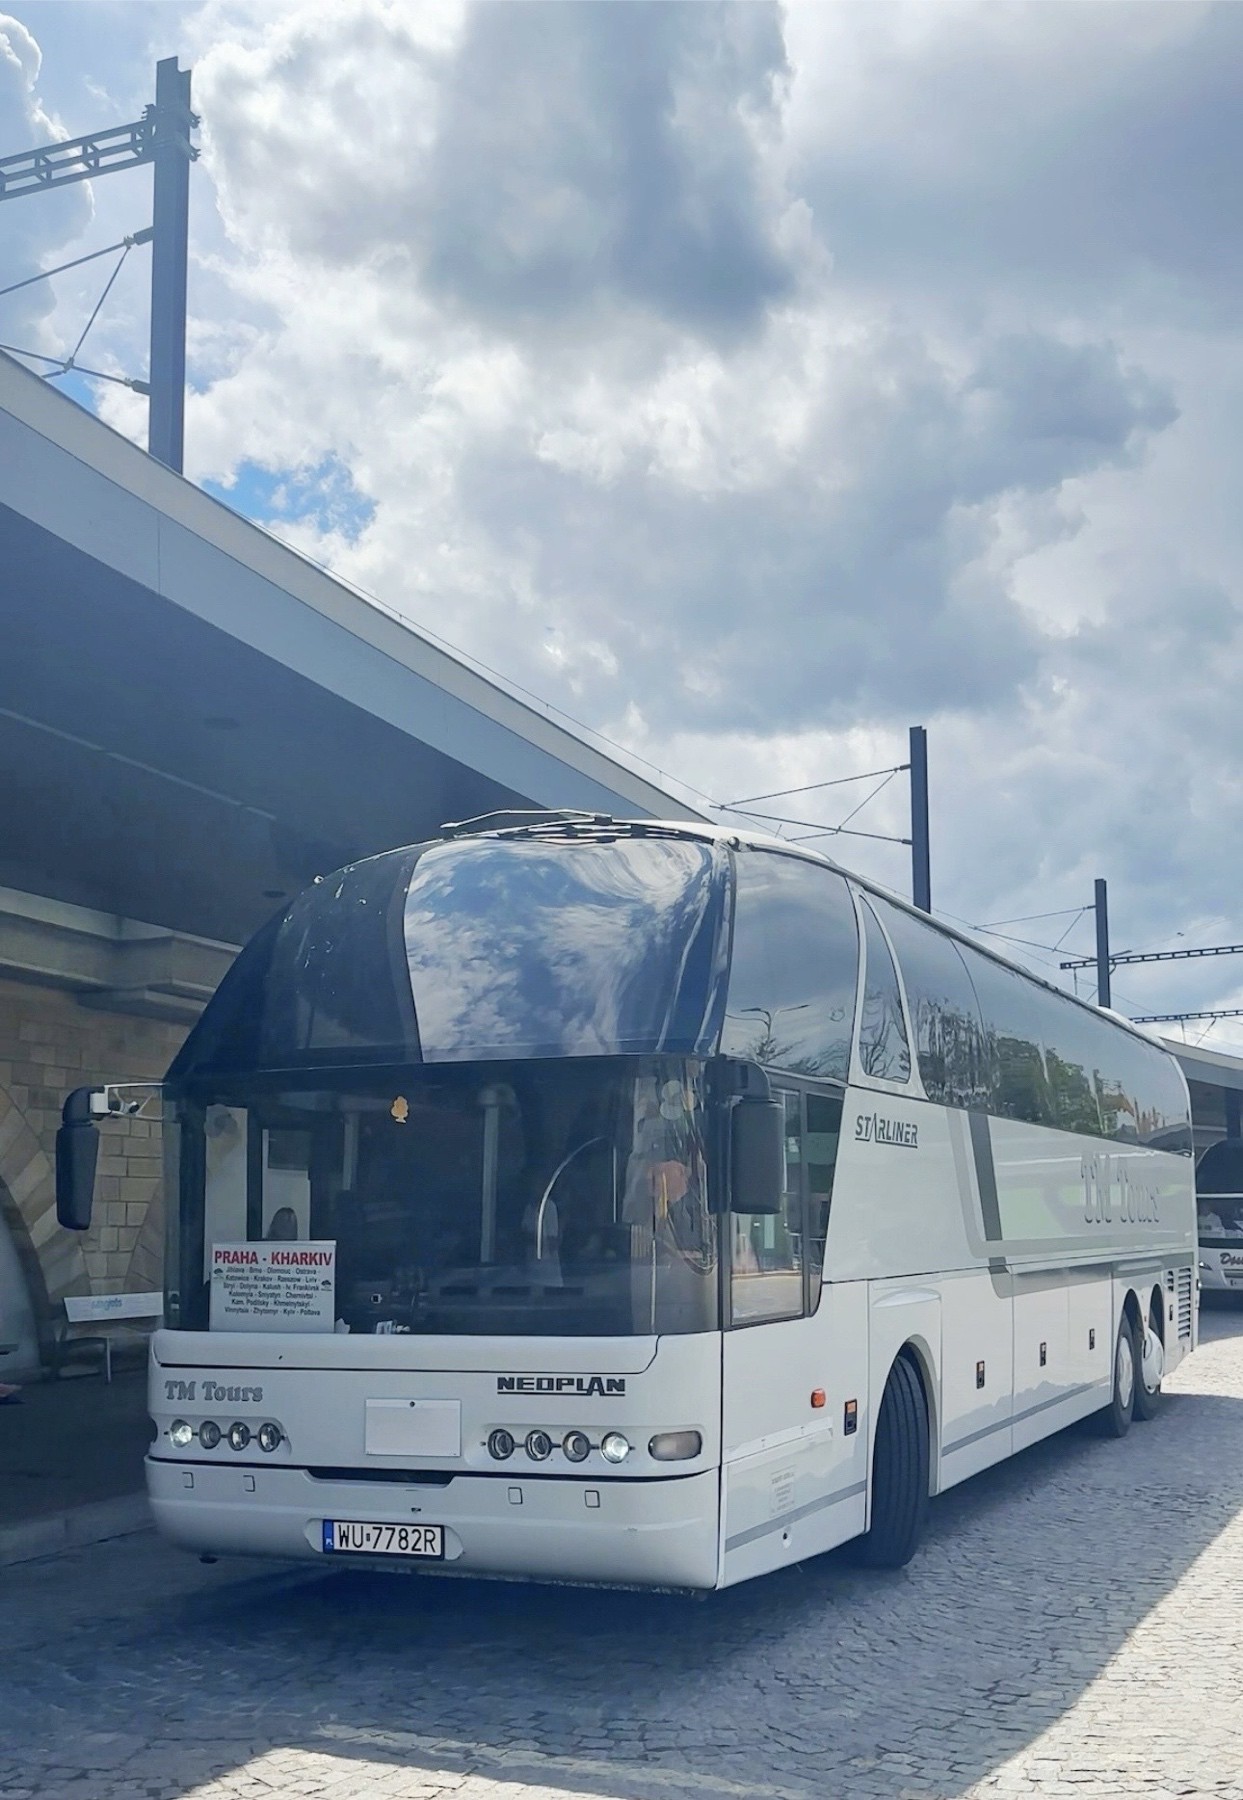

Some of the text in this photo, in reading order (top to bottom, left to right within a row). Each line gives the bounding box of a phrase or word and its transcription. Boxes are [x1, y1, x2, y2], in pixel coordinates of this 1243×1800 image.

[855, 1113, 918, 1147] STARLINER
[214, 1251, 259, 1264] PRAHA
[271, 1252, 332, 1266] KHARKIV
[165, 1381, 263, 1402] TM Tours
[497, 1377, 625, 1396] NEOPLAN
